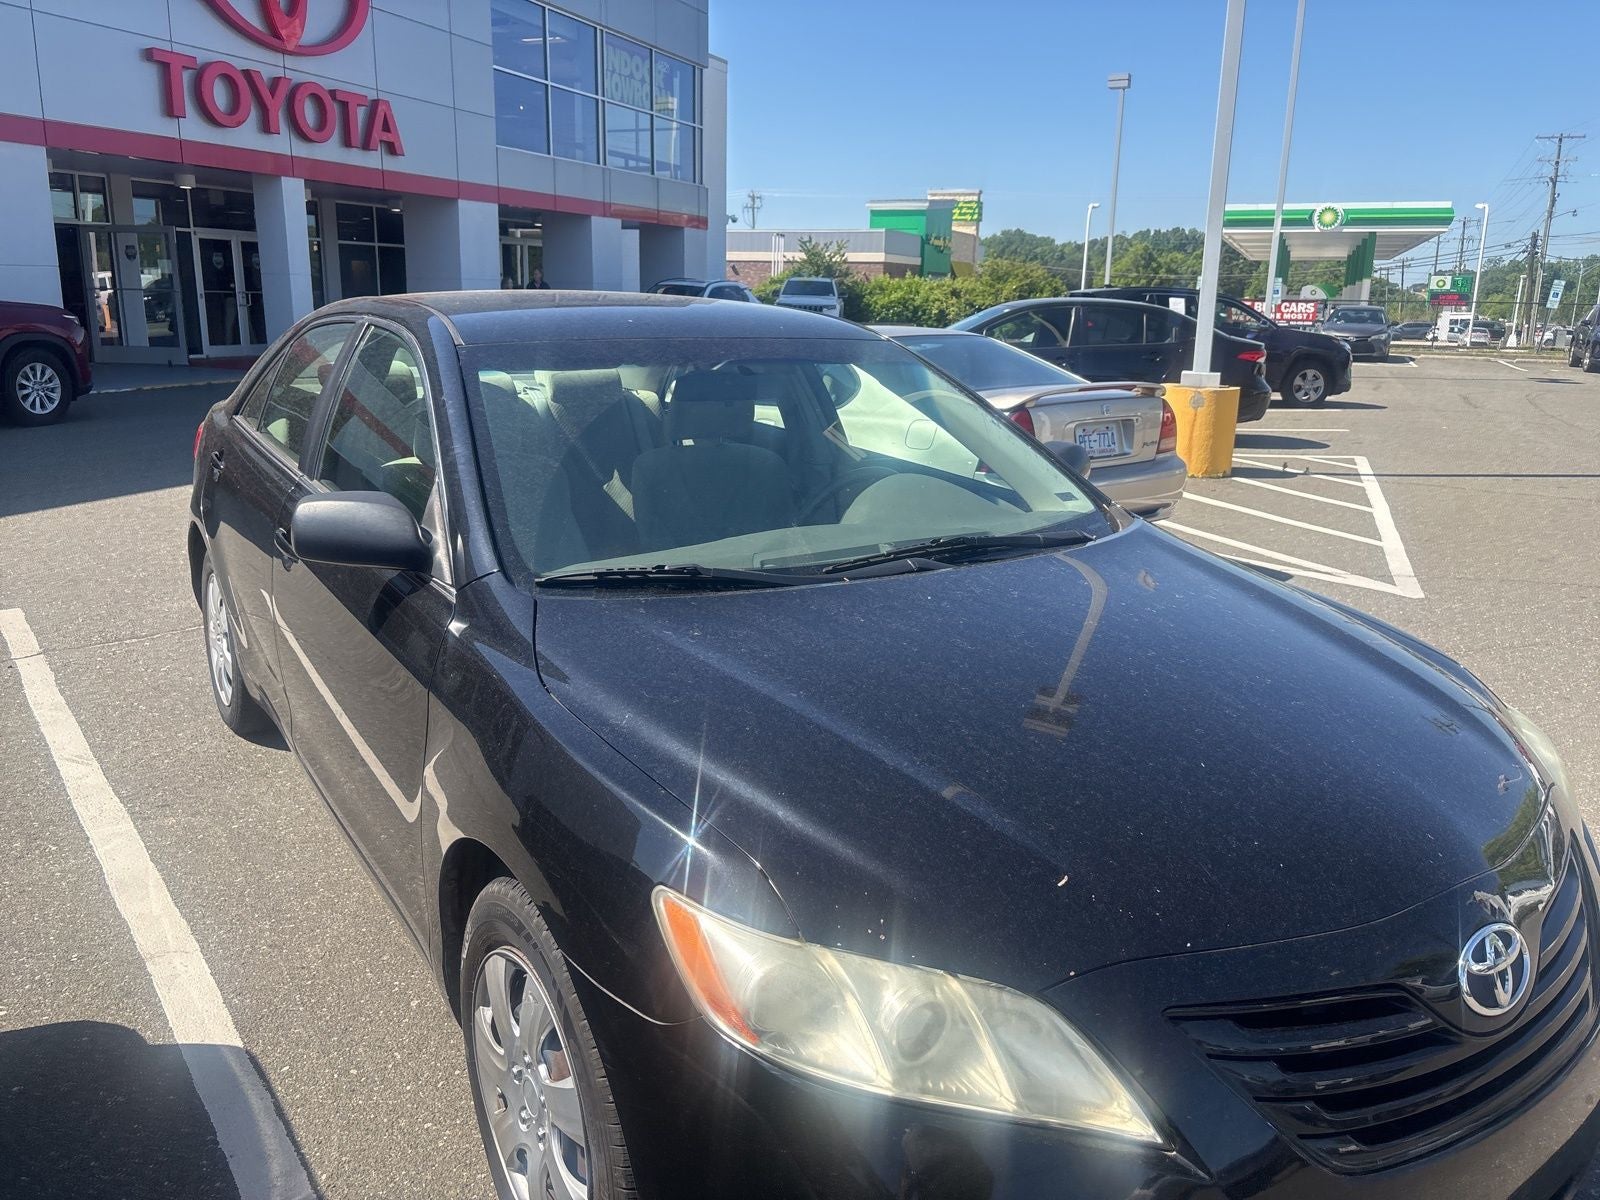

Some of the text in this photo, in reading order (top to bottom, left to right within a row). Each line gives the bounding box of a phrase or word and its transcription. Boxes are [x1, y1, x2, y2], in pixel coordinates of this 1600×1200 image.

[606, 44, 665, 89] NDOOR
[143, 46, 406, 157] TOYOTA
[1280, 302, 1315, 313] CARS
